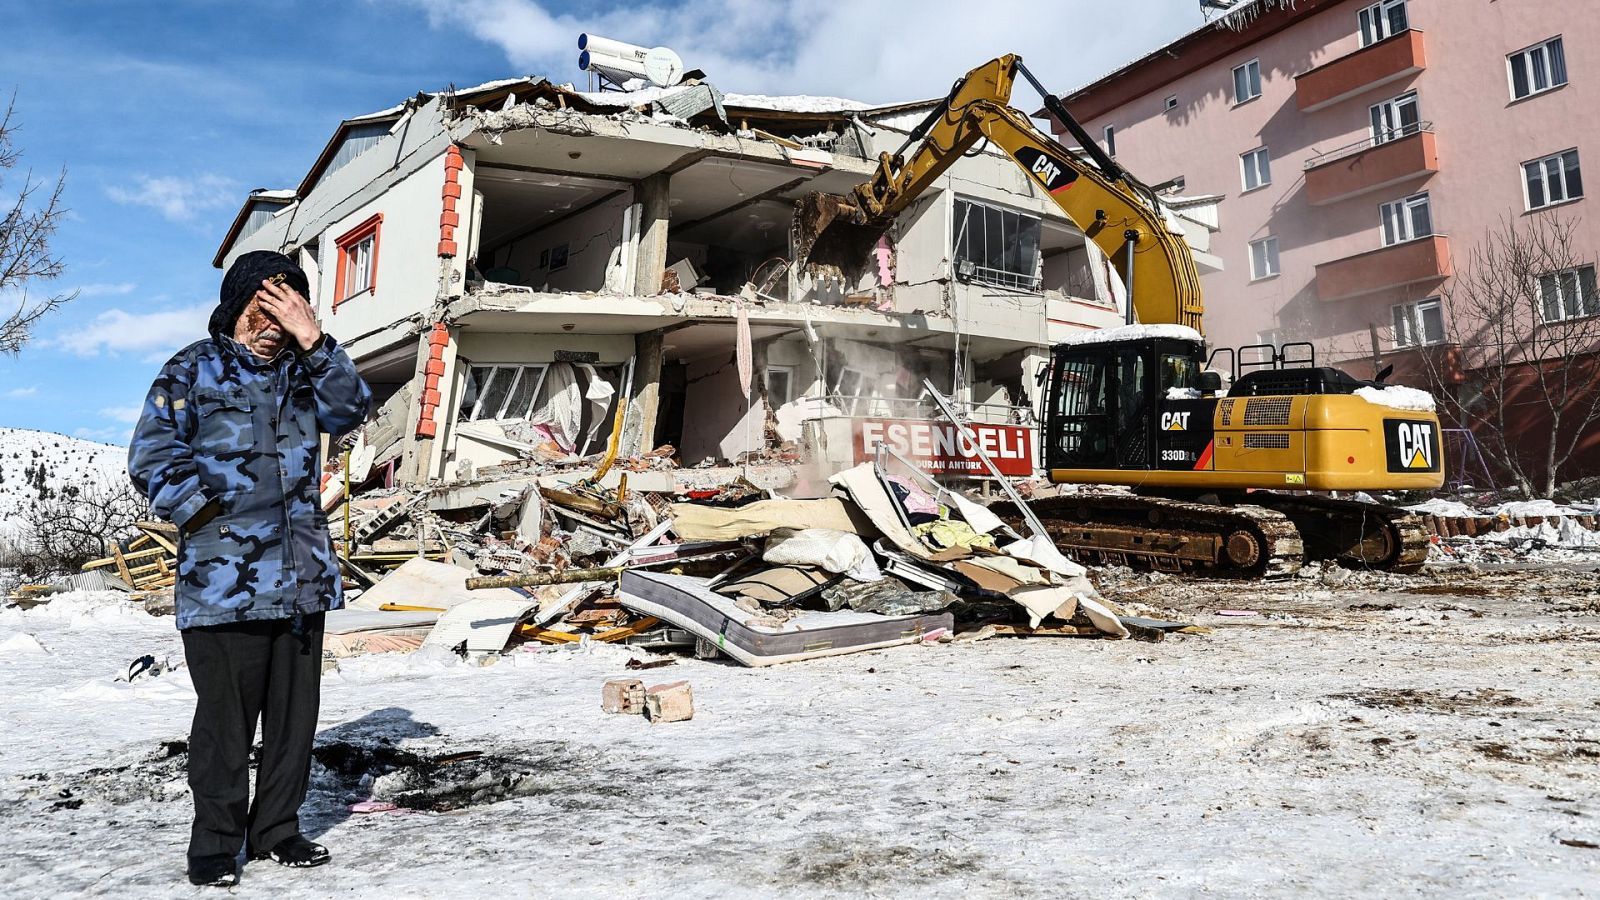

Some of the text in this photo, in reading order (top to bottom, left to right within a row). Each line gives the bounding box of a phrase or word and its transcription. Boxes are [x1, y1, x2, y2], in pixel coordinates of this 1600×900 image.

[1032, 154, 1061, 187] CAT
[1161, 411, 1191, 431] CAT
[1398, 422, 1433, 468] CAT
[917, 460, 945, 469] DURAN
